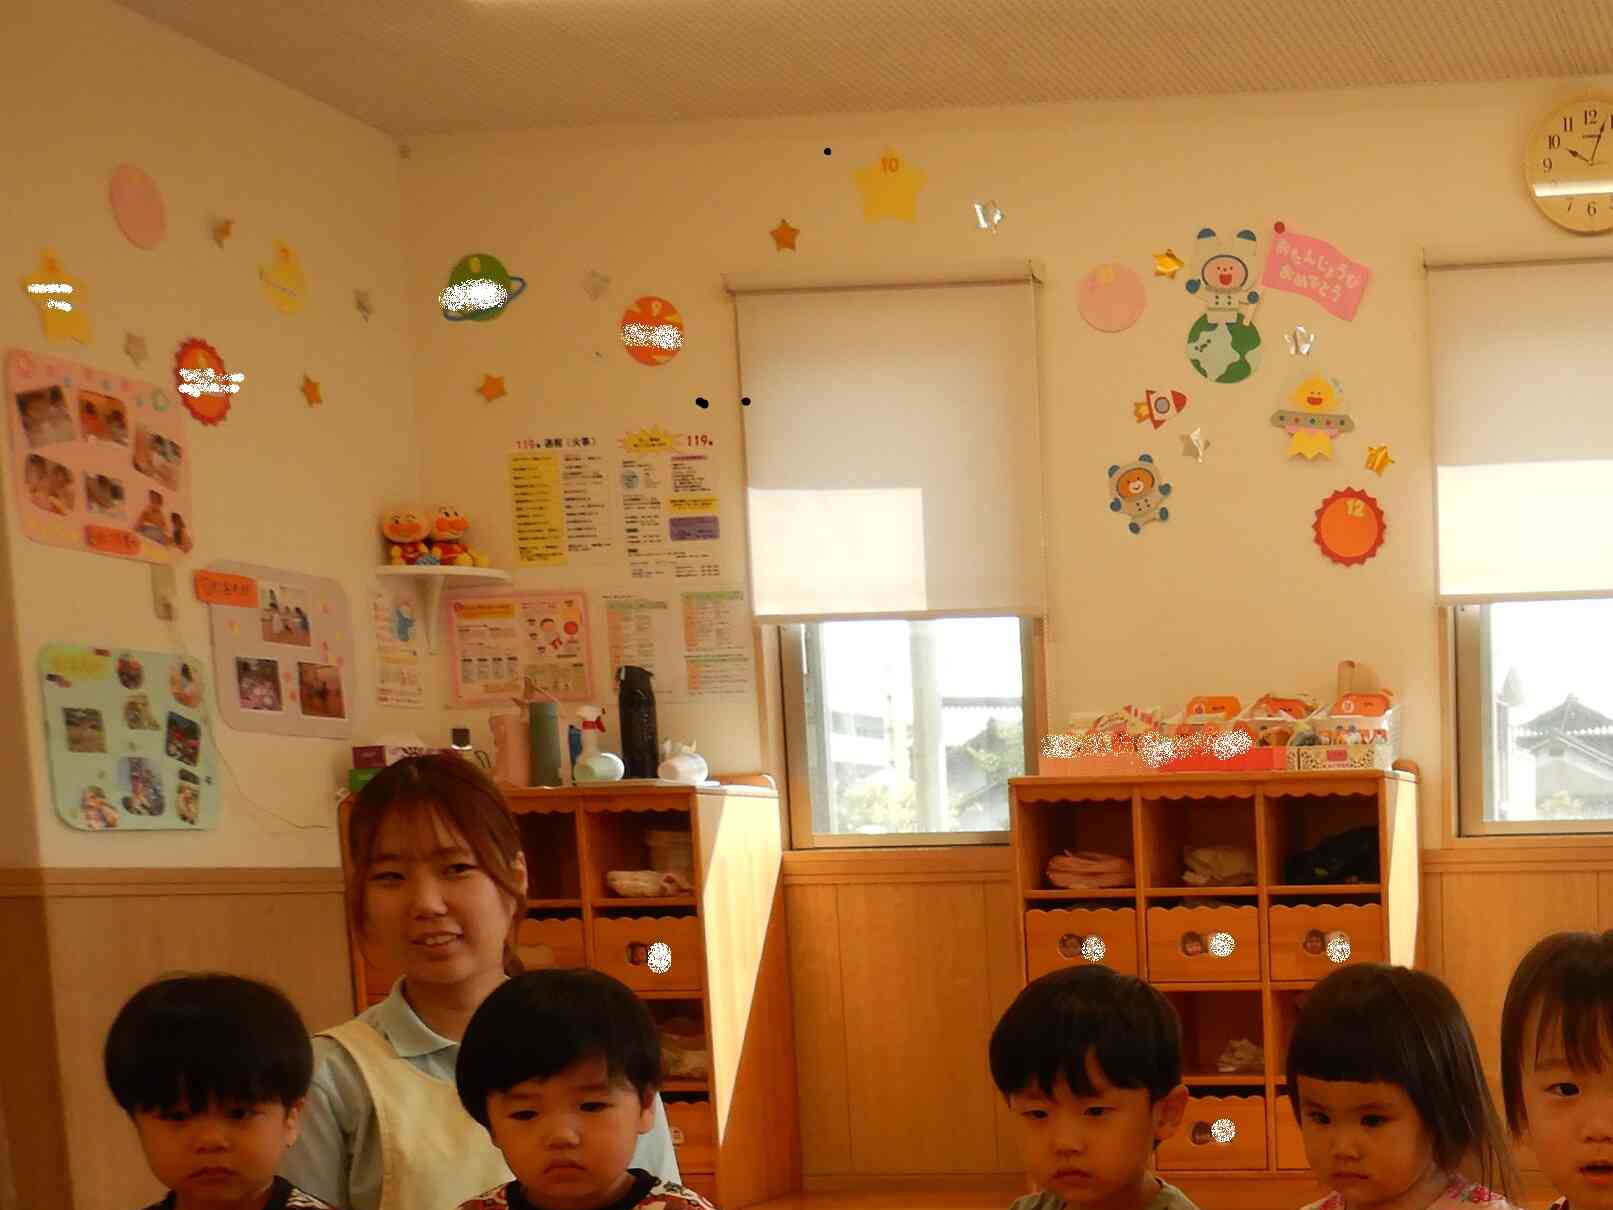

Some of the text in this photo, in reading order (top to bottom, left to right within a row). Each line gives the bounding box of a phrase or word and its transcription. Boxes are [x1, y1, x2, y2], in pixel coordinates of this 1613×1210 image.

[1563, 116, 1573, 132] 11
[1584, 109, 1598, 126] 12
[1548, 134, 1560, 150] 10
[881, 157, 900, 173] 10
[1543, 158, 1552, 174] 9
[1565, 197, 1574, 212] 7
[1587, 201, 1597, 216] 6
[651, 301, 664, 318] 9
[1345, 499, 1366, 518] 12
